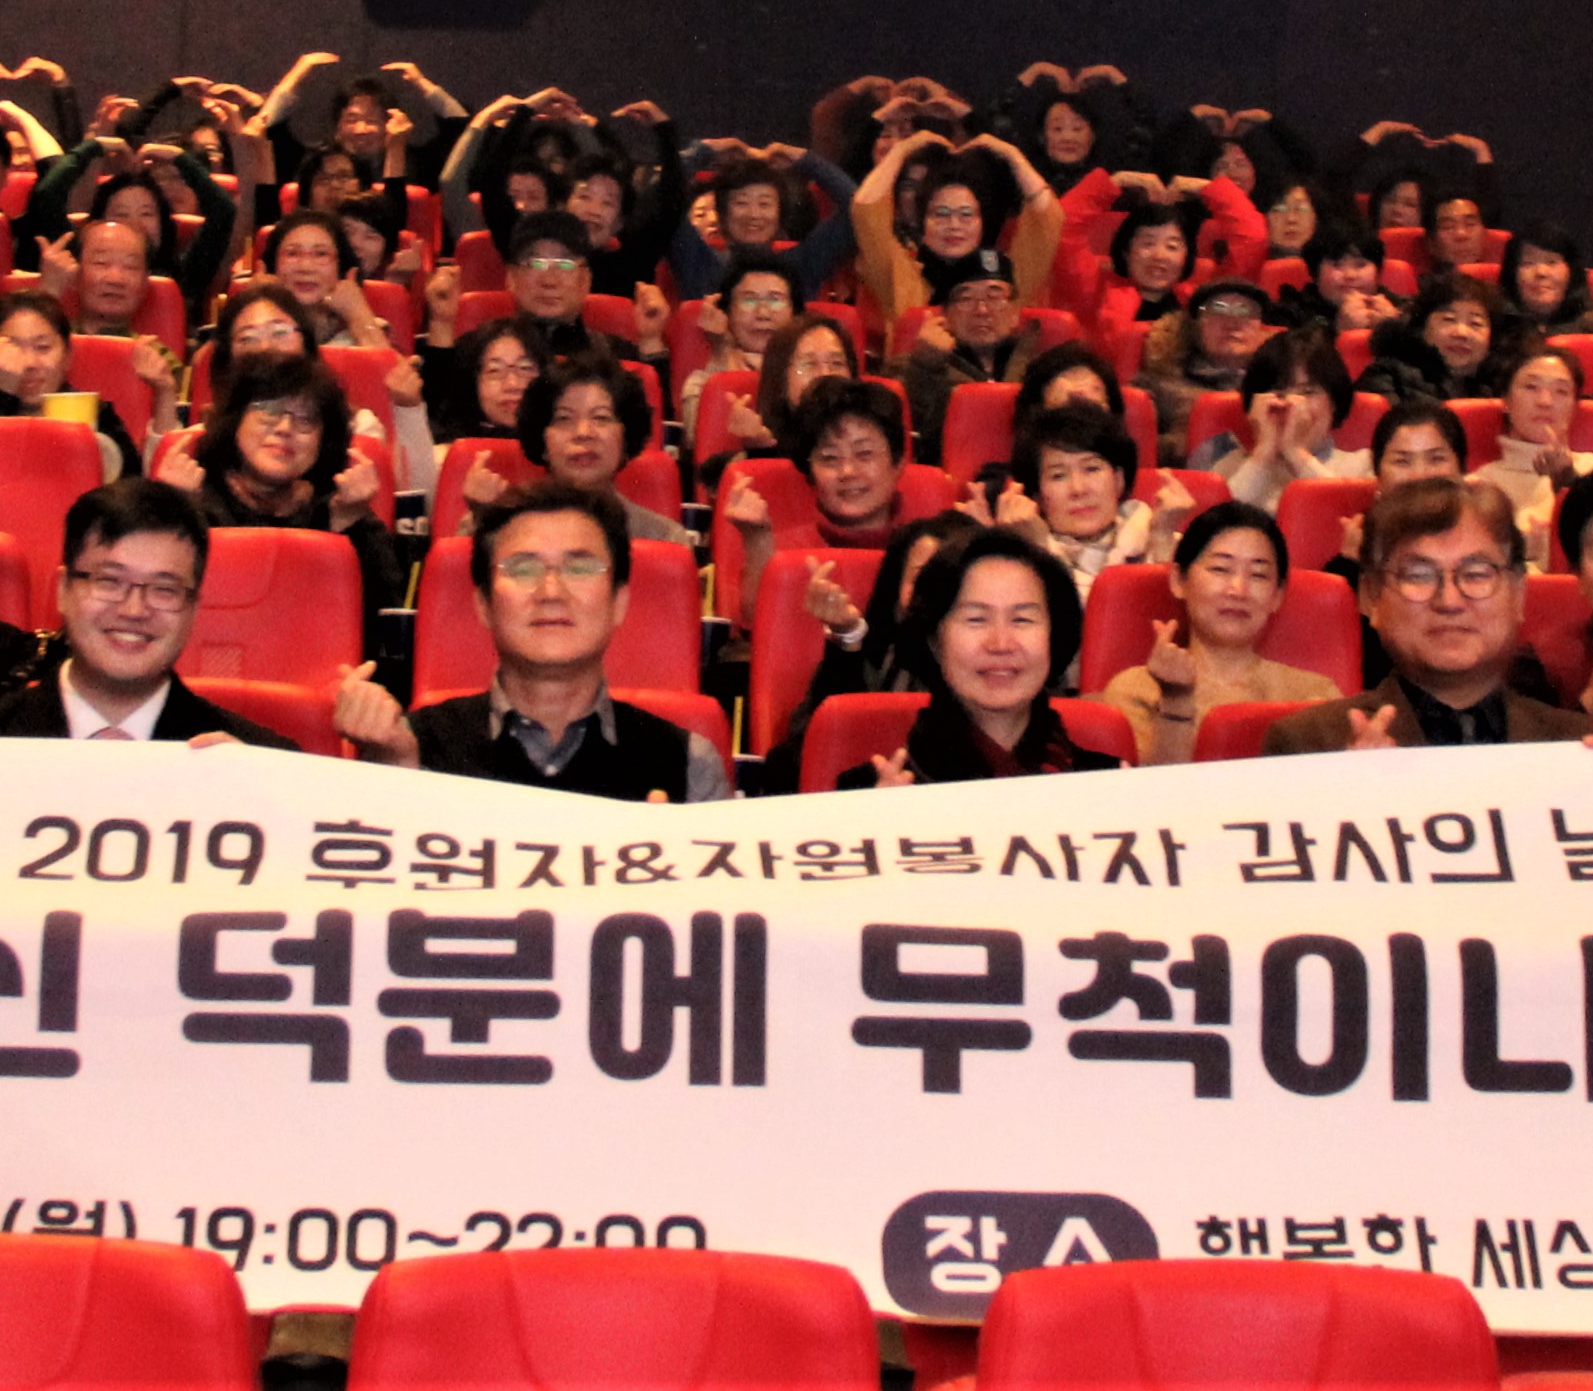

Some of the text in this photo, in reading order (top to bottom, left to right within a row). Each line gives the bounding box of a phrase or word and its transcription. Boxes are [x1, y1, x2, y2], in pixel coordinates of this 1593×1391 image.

[18, 815, 265, 886] 2019
[306, 820, 1186, 890] 후원자&자원봉사자
[1223, 808, 1515, 885] 감사의
[176, 910, 768, 1088] 덕분에
